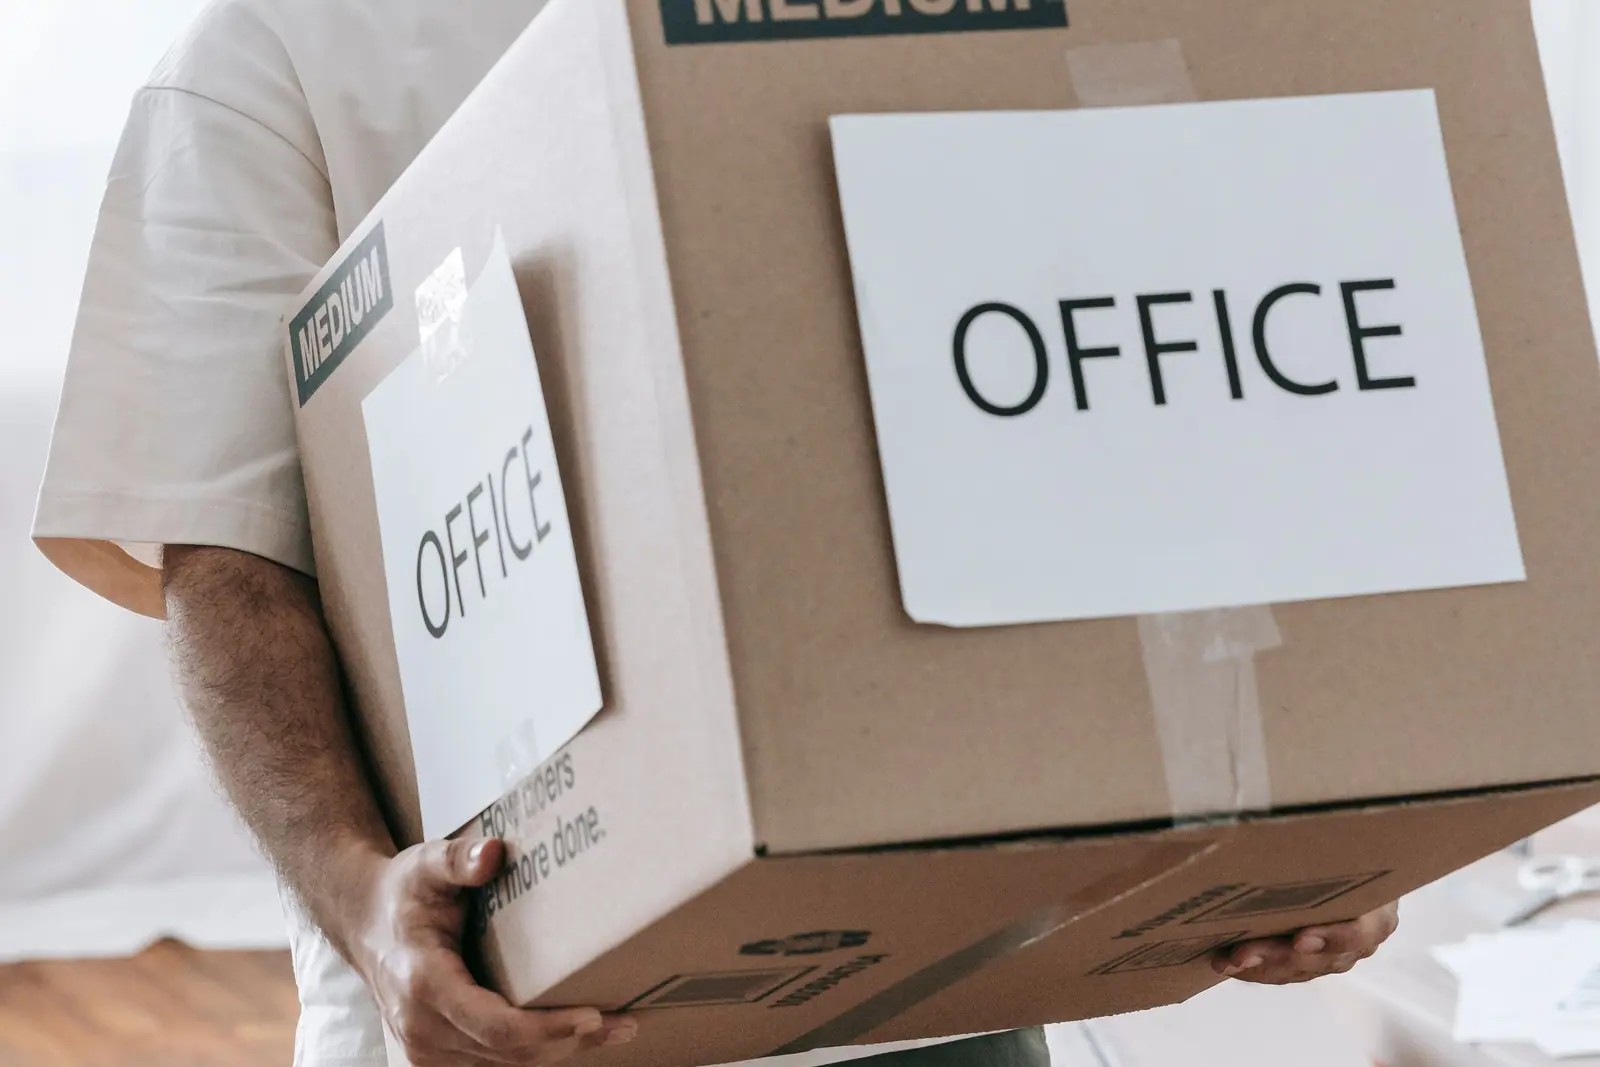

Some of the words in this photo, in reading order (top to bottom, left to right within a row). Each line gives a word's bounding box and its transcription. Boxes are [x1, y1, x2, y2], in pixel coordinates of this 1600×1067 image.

[298, 245, 384, 382] MEDIUM
[952, 278, 1417, 417] OFFICE
[416, 424, 552, 639] OFFICE
[503, 841, 550, 905] more
[553, 804, 607, 868] done.
